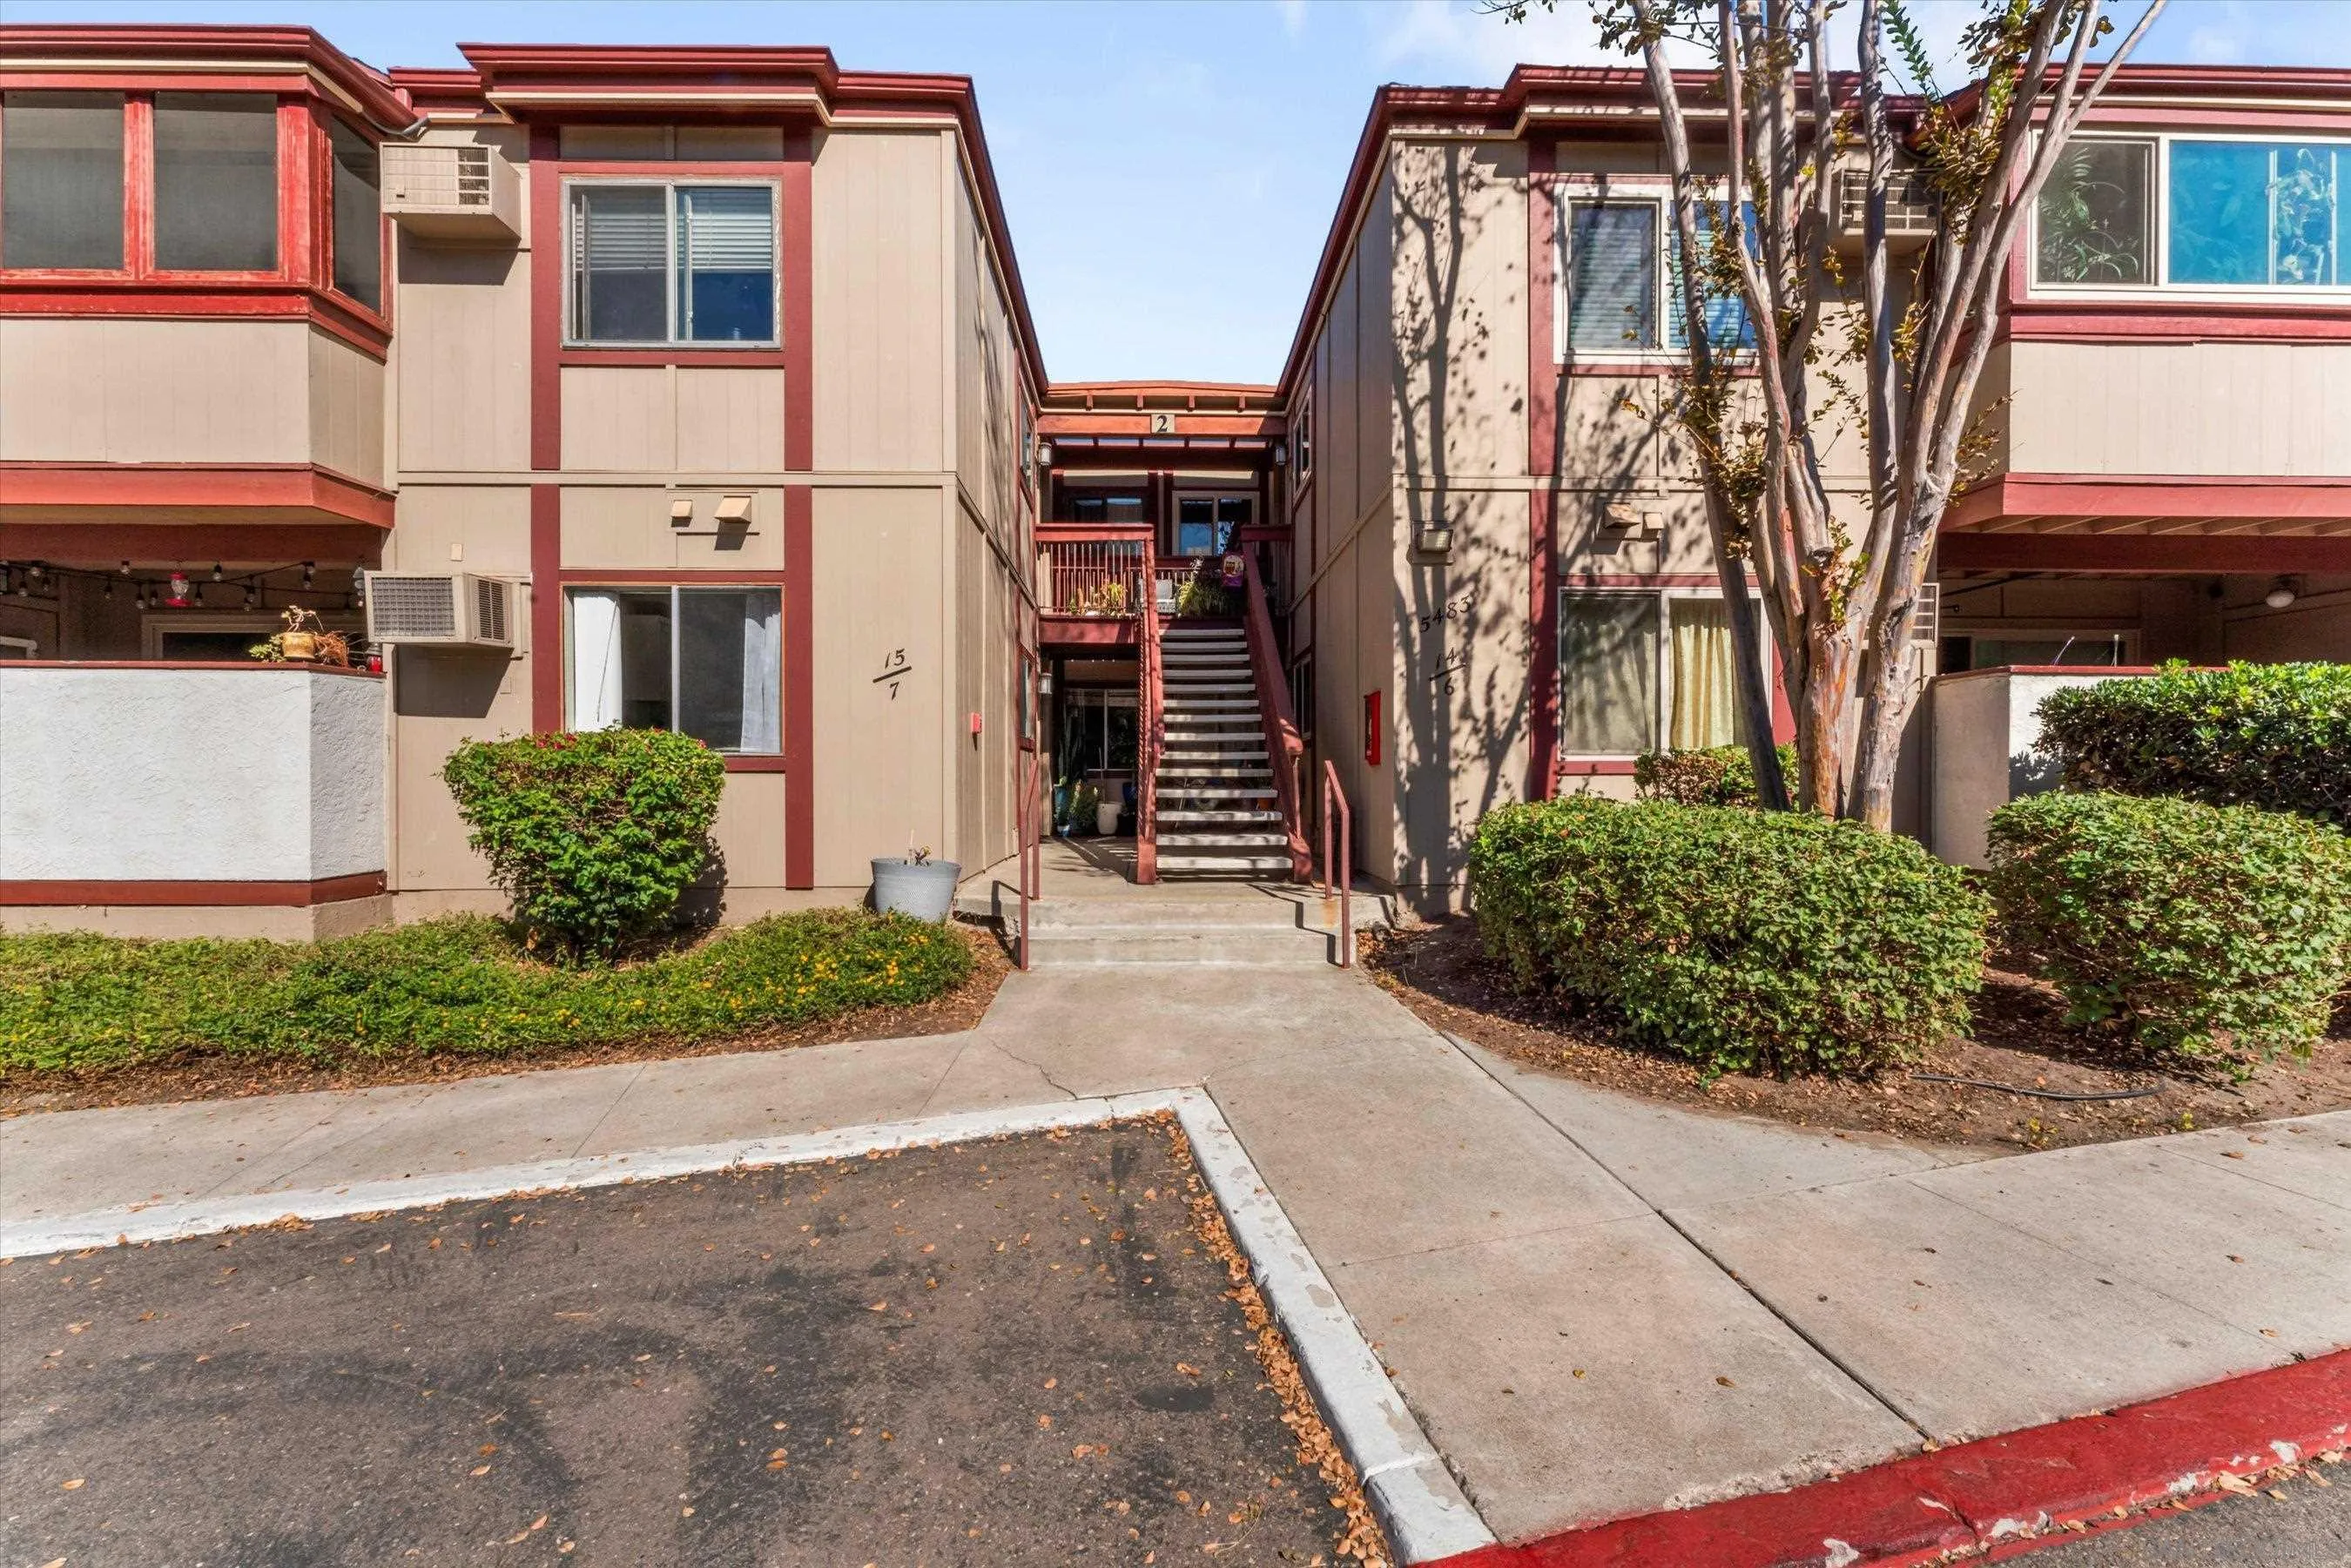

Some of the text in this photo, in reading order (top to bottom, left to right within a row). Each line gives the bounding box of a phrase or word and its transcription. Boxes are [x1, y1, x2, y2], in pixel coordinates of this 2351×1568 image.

[1156, 414, 1168, 433] 2
[1420, 595, 1470, 633] 5483
[885, 648, 906, 670] 15
[1436, 647, 1458, 670] 14
[890, 681, 900, 701] 7
[1445, 676, 1455, 696] 6
